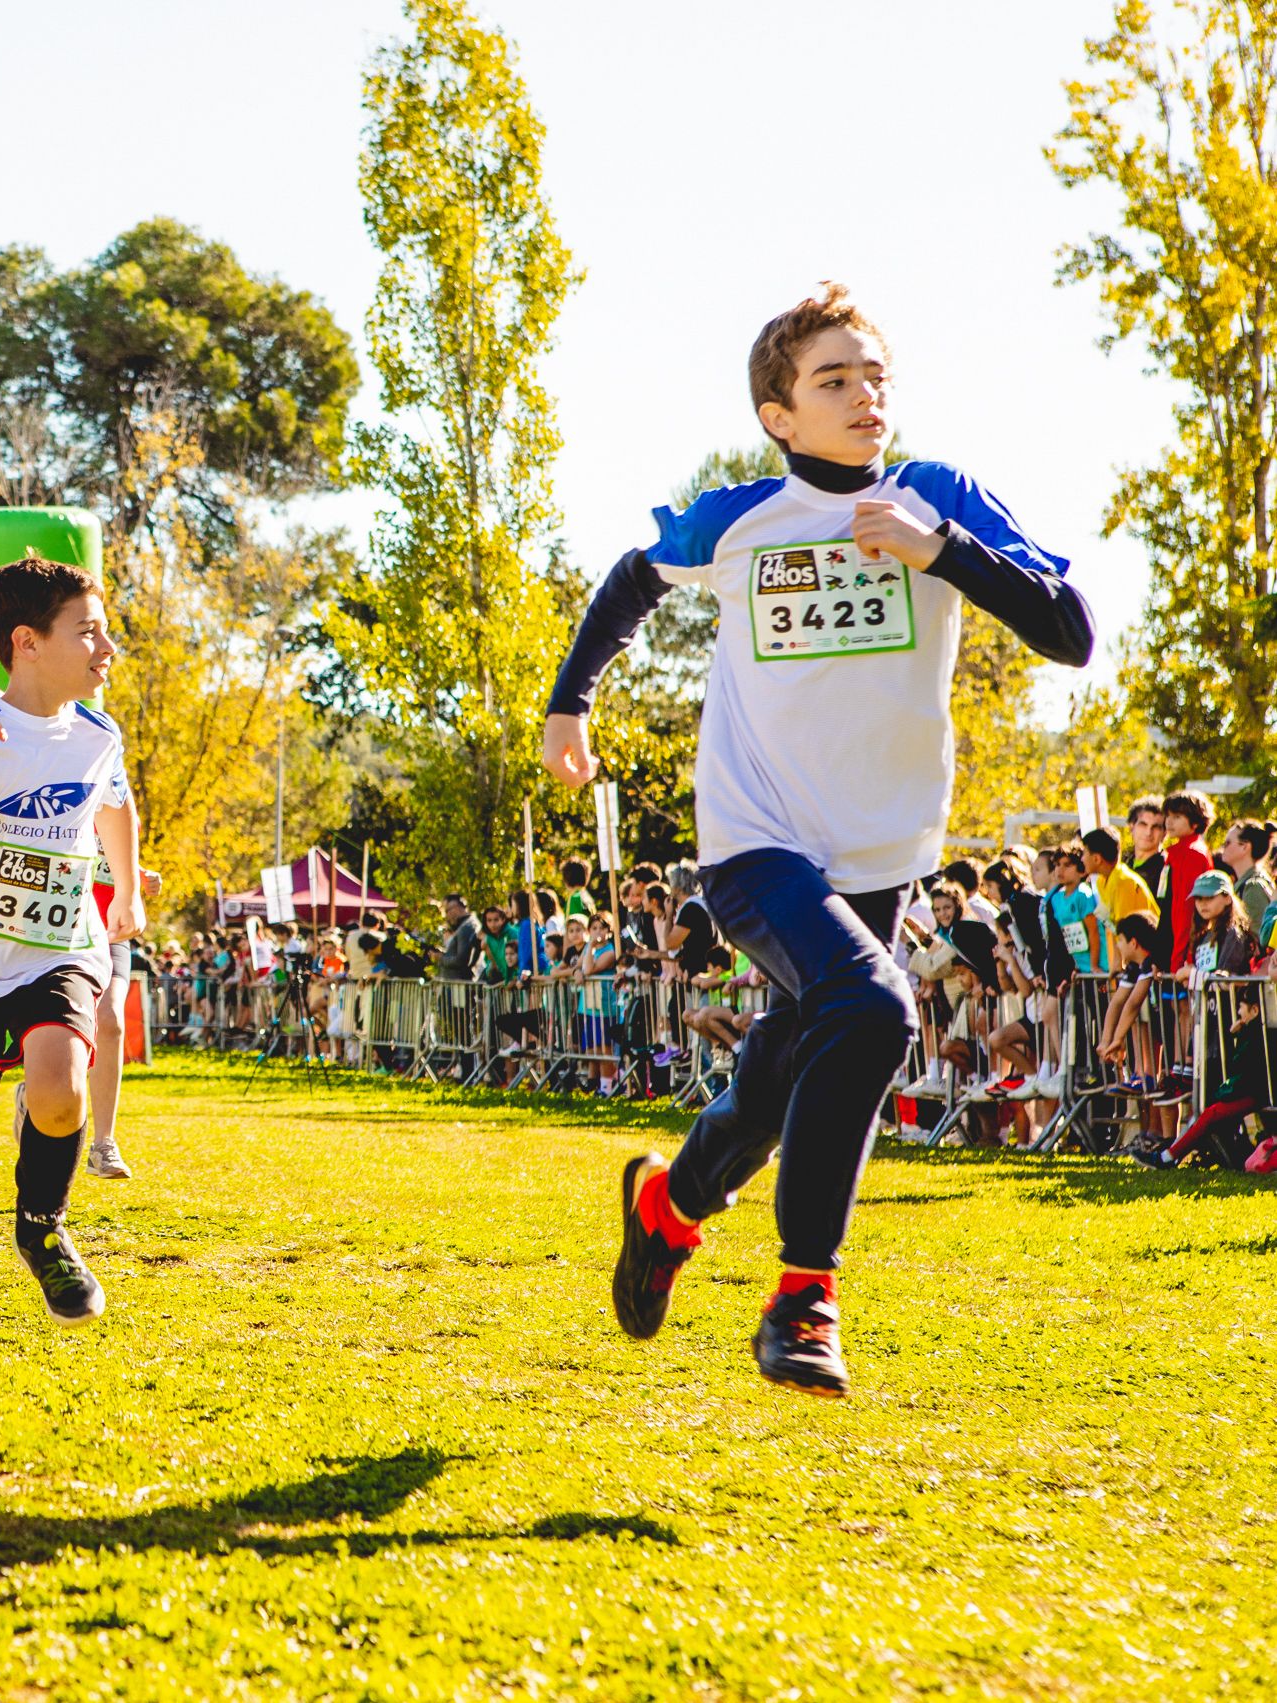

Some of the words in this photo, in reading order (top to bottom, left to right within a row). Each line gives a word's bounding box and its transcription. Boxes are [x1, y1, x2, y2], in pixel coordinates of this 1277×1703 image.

[761, 566, 816, 587] CROS
[771, 598, 885, 633] 3423
[0, 864, 46, 885] CROS
